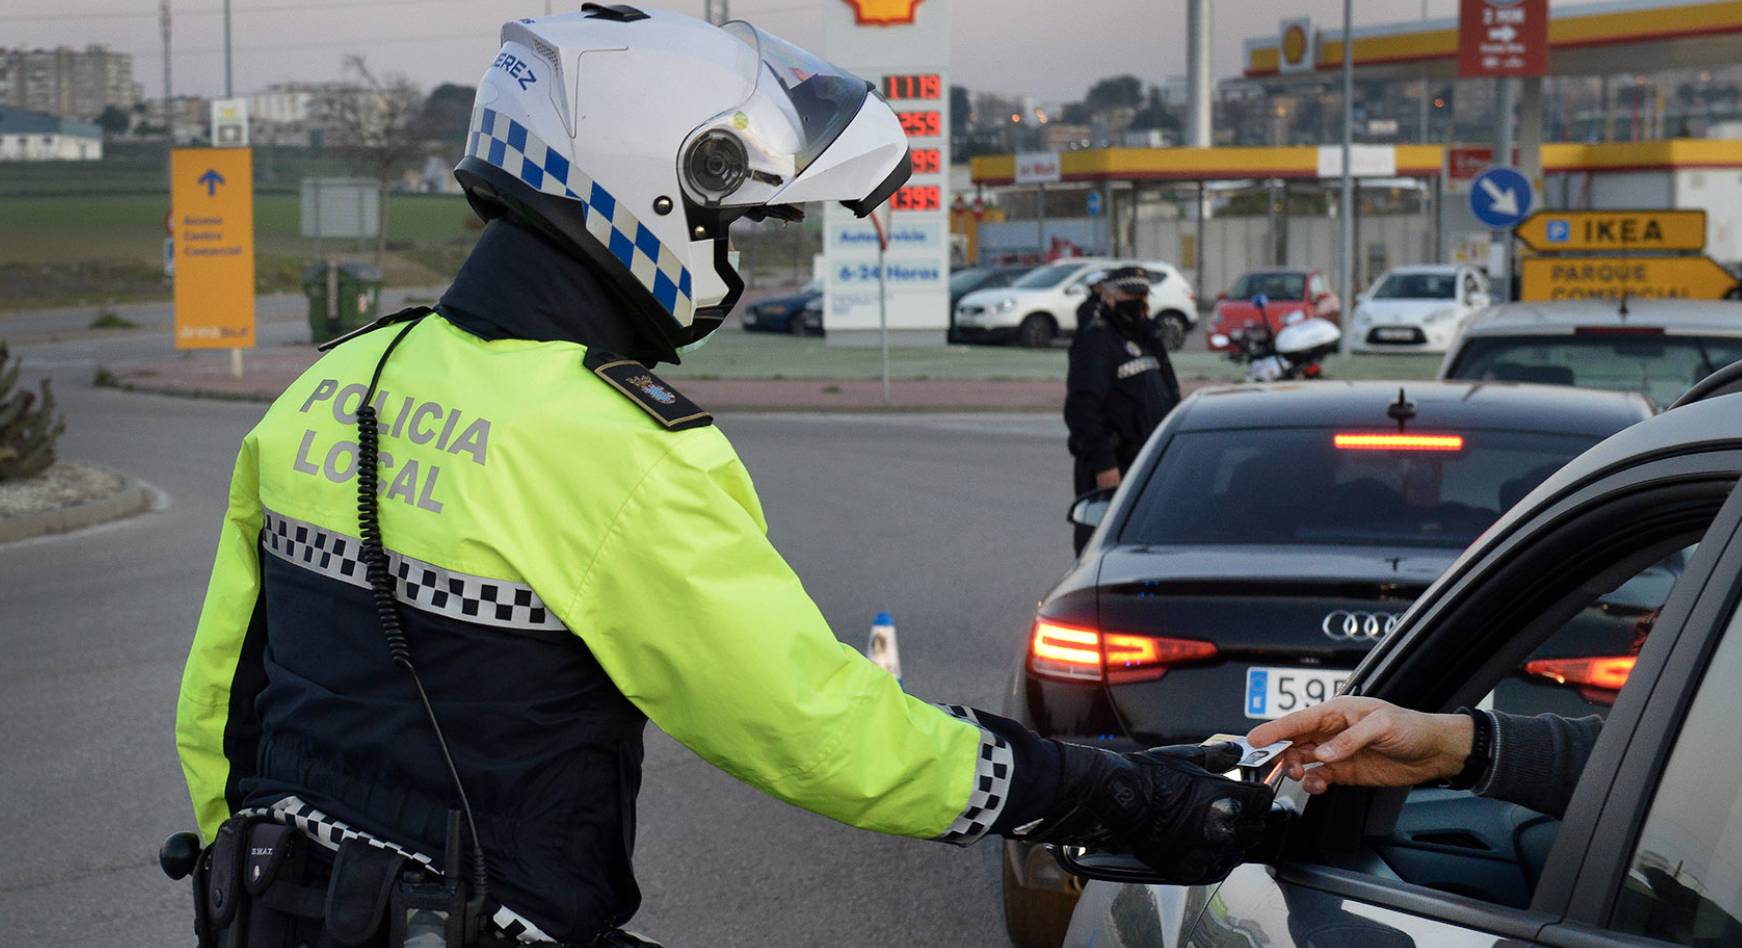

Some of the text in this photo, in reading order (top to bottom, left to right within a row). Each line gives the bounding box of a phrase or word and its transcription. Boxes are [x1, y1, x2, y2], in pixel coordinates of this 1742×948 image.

[493, 52, 537, 91] EREZ
[896, 111, 940, 136] 259
[910, 149, 940, 173] 99
[1584, 219, 1663, 242] IKEA
[1552, 264, 1646, 282] PARQUE
[299, 379, 491, 466] POLICIA
